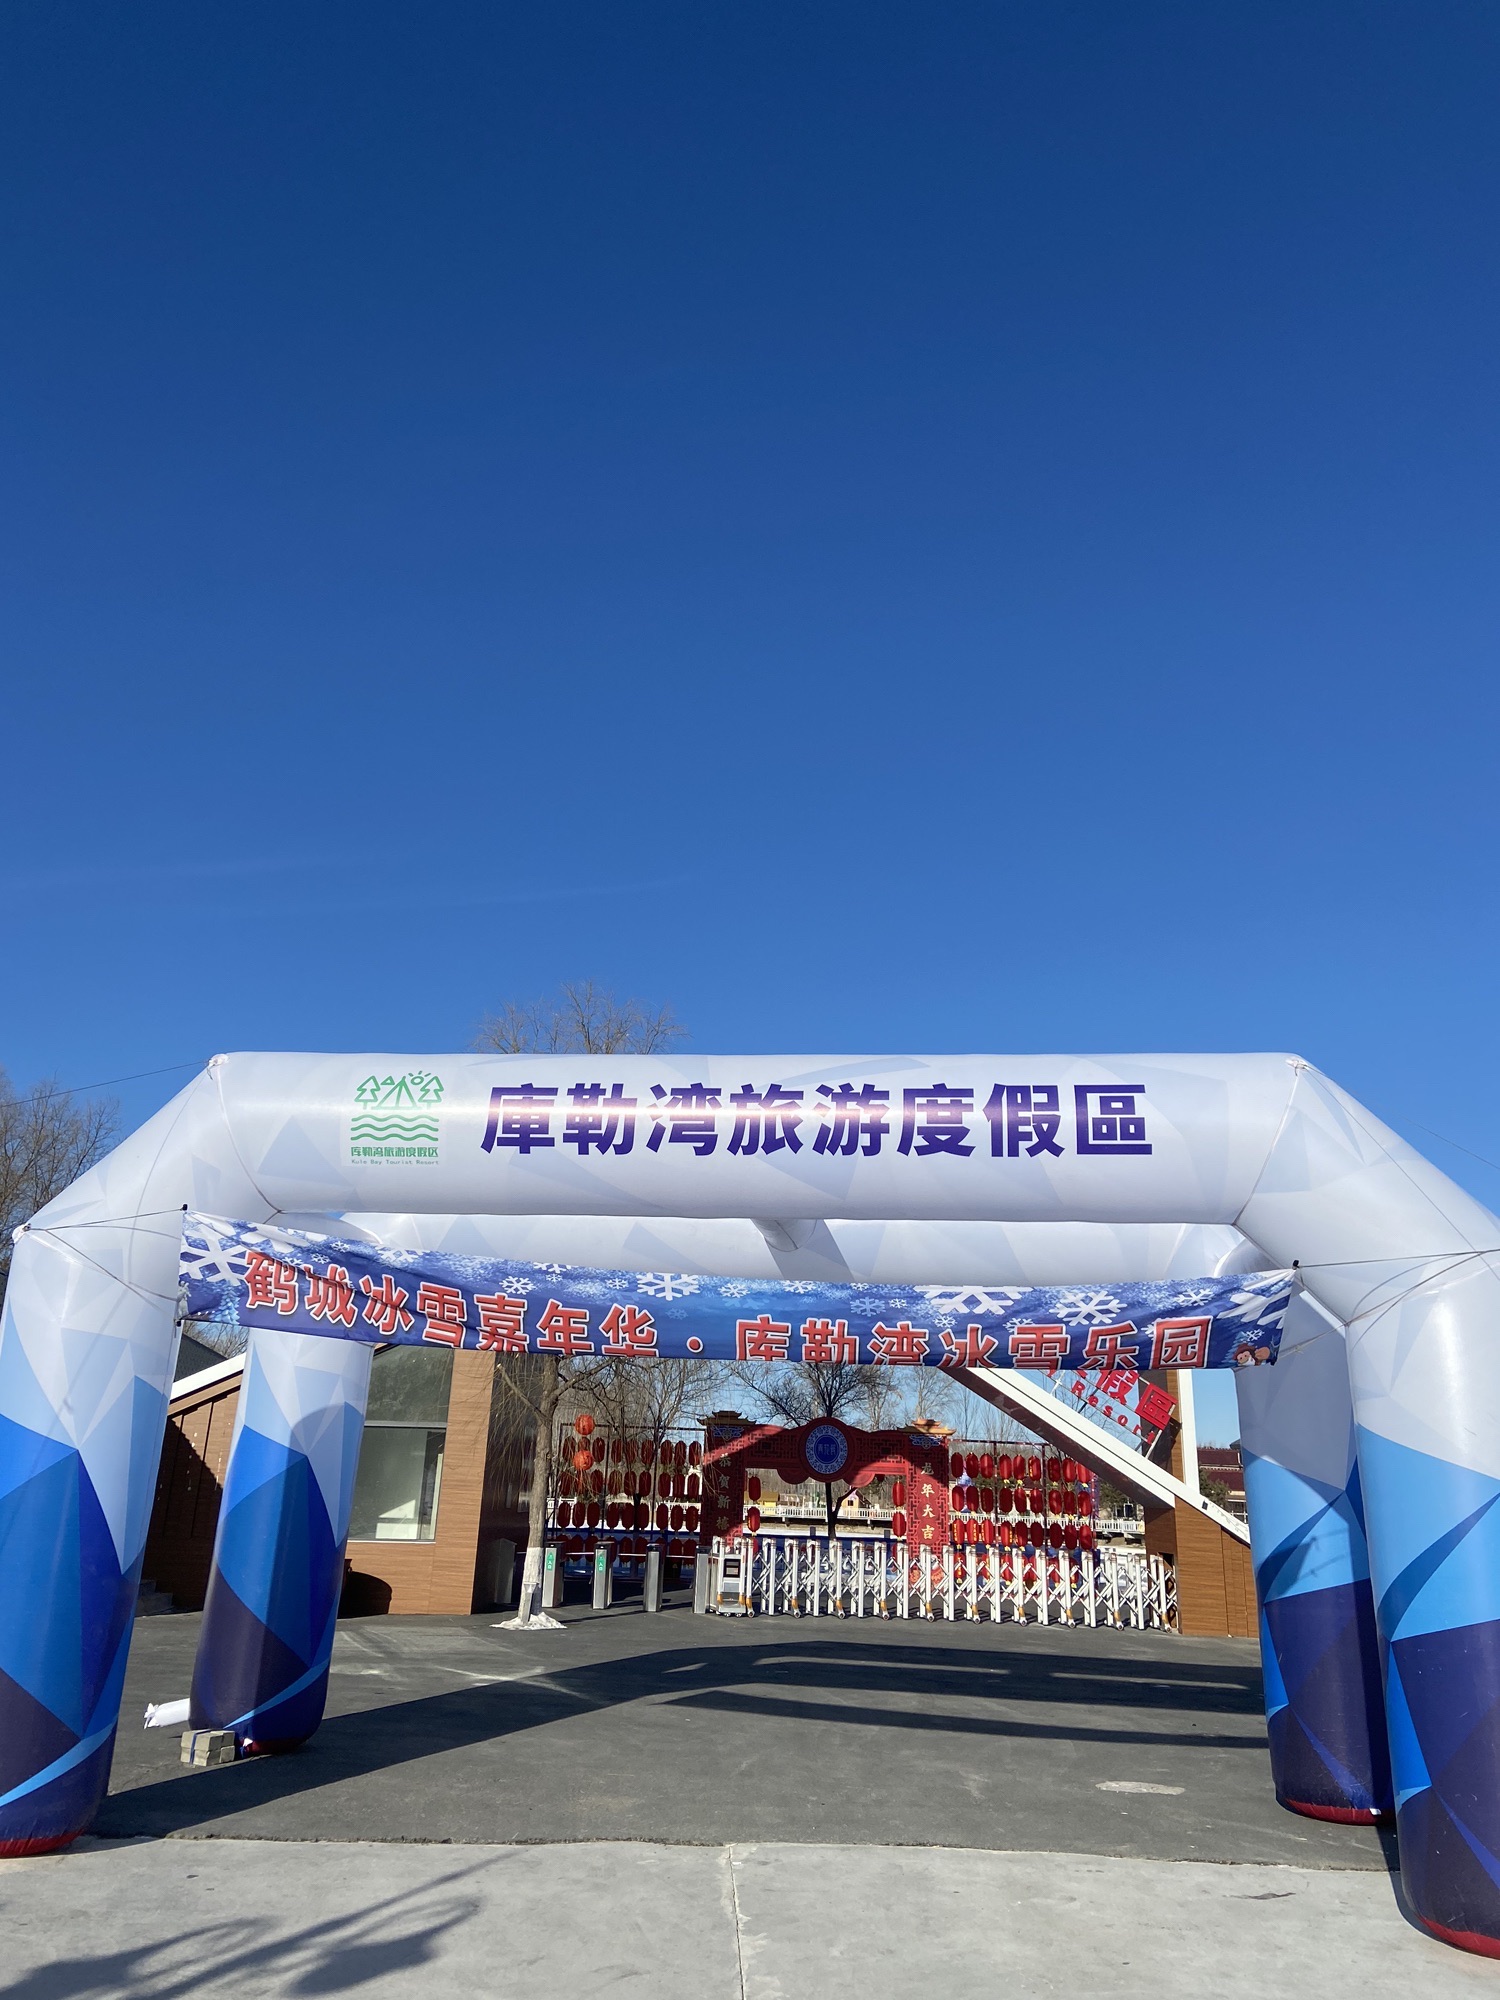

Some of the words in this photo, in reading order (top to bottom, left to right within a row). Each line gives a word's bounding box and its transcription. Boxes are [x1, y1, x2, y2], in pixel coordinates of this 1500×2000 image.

[350, 1146, 439, 1158] 库勒湾旅游度假区
[480, 1082, 1153, 1158] 庫勒湾旅游度假區
[920, 1462, 936, 1540] 龙年大吉
